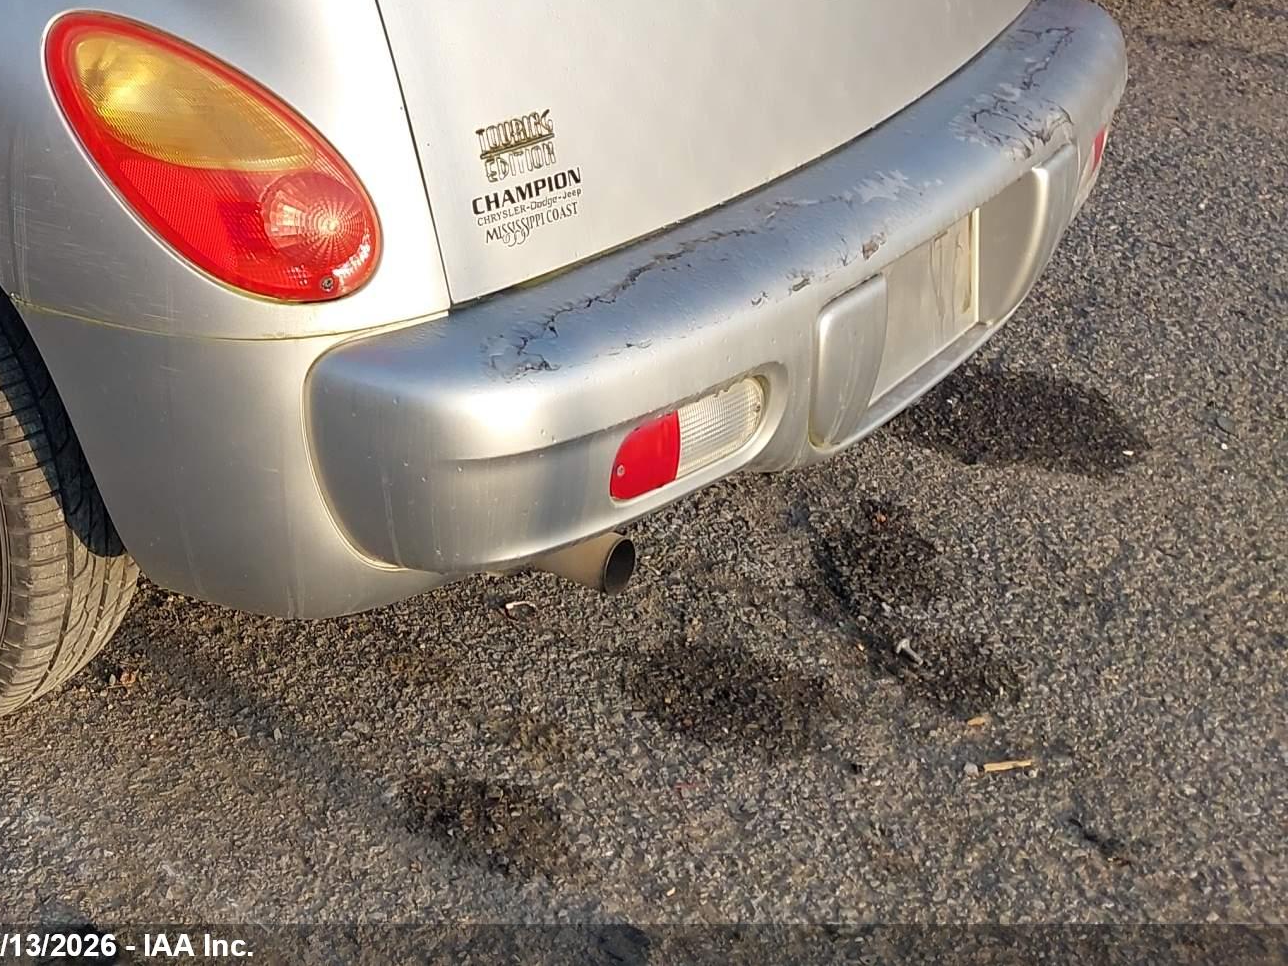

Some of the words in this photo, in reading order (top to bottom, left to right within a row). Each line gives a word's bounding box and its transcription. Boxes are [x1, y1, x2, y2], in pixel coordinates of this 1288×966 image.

[475, 108, 554, 154] TOURING
[484, 141, 557, 183] EDITION
[472, 167, 581, 216] CHAMPION
[485, 212, 546, 247] MISSISSIPPI
[546, 201, 578, 224] COAST
